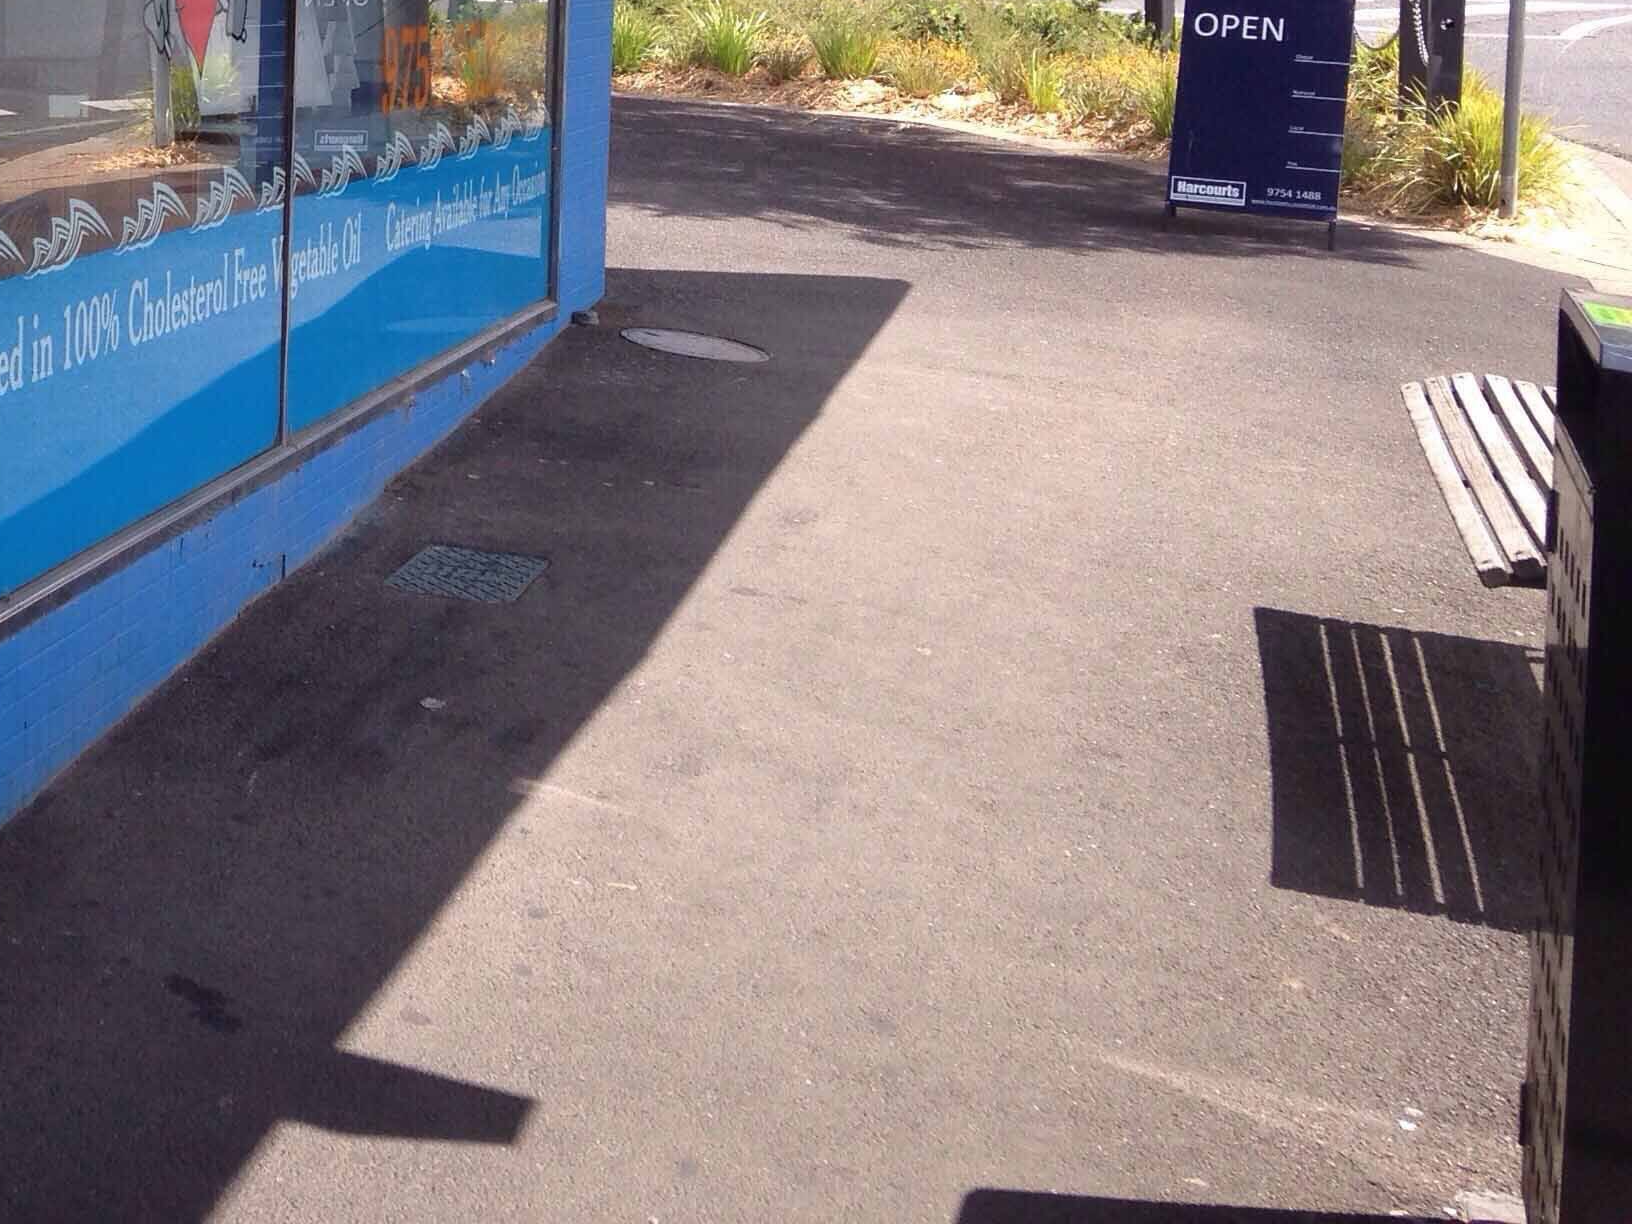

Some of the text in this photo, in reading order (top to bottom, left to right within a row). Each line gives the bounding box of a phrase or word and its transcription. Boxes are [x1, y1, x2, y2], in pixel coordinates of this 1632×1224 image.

[1194, 12, 1285, 42] OPEN
[1176, 180, 1240, 198] Harcourts
[1267, 187, 1321, 201] 9754 1488
[385, 196, 433, 251] Catering
[433, 178, 478, 236] Available
[479, 175, 492, 218] for
[493, 171, 511, 220] Any
[31, 314, 54, 384] in
[63, 288, 120, 371] 100%
[127, 248, 230, 347] Cholesterol
[232, 248, 267, 308] Free
[271, 221, 339, 301] Vgetable
[341, 212, 363, 271] Oil
